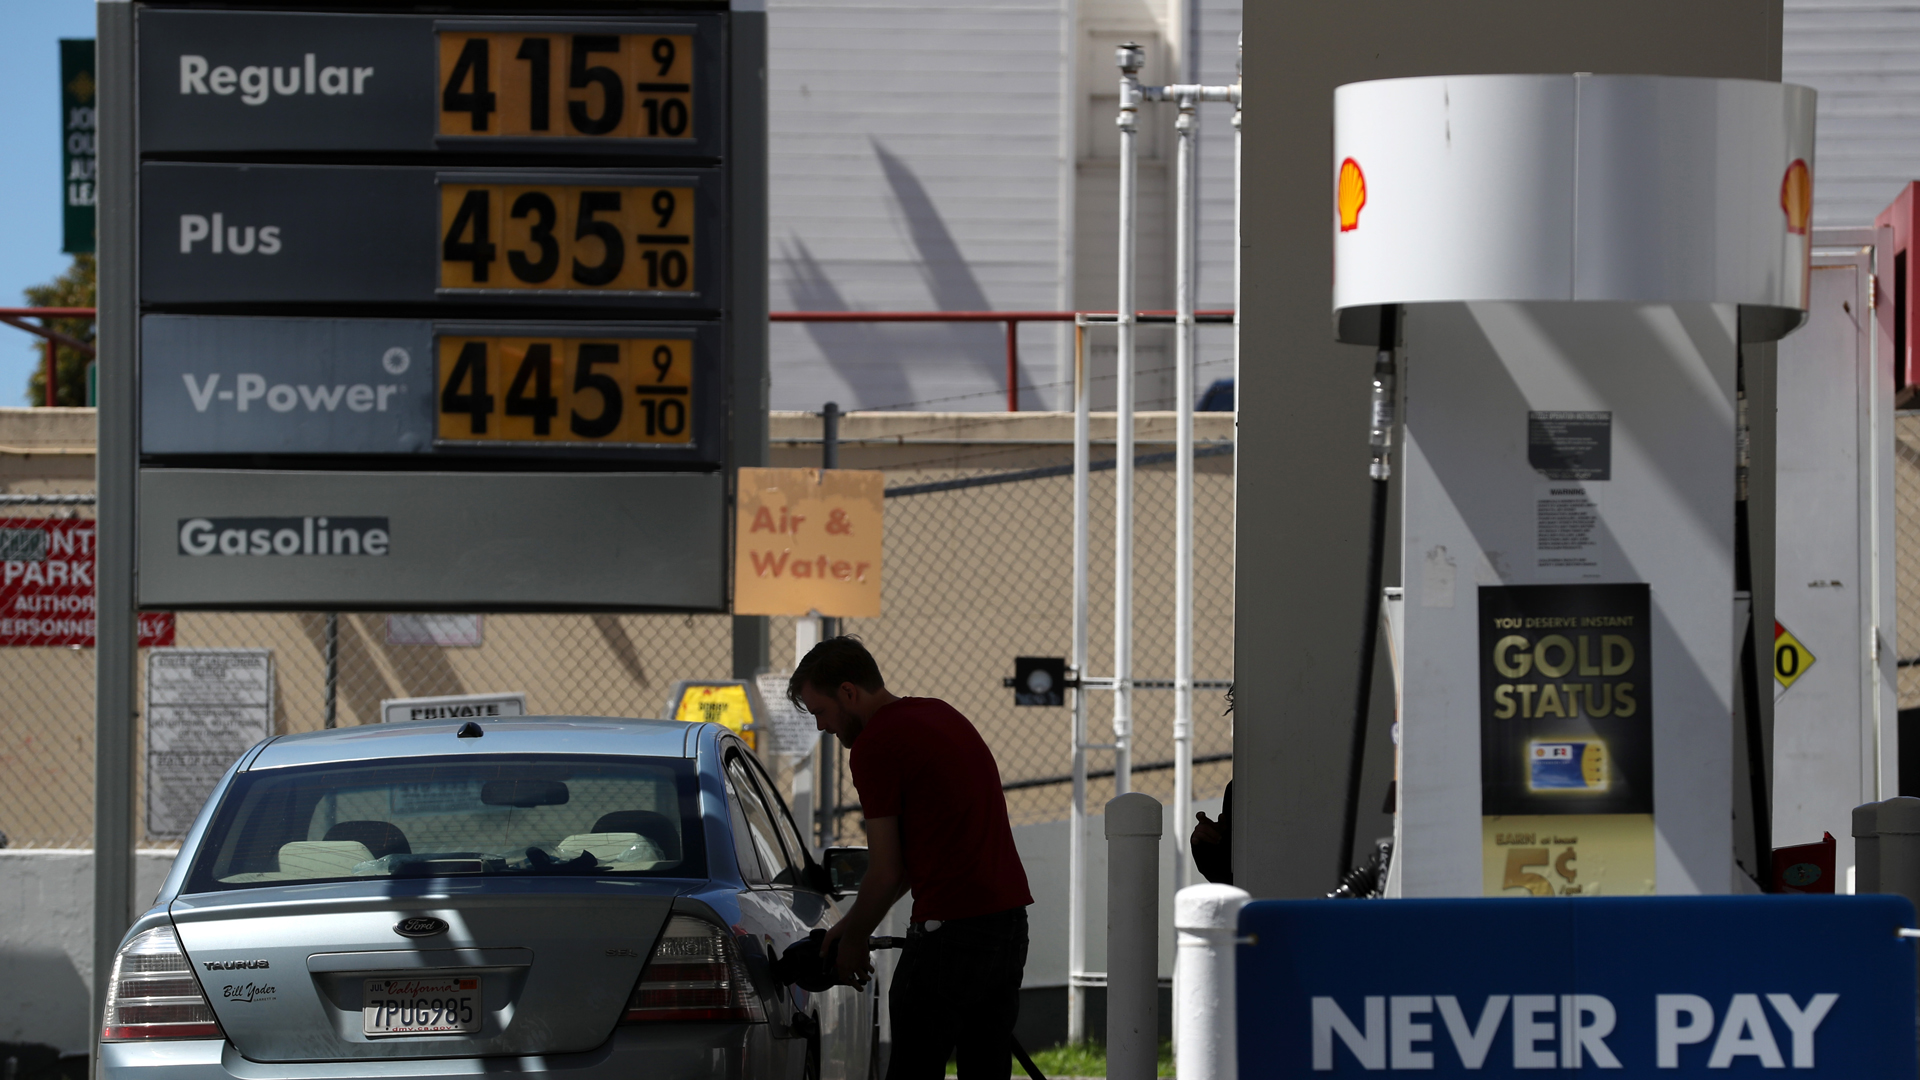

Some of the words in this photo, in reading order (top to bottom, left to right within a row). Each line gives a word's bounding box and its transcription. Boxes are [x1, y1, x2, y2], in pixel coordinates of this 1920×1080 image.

[652, 38, 675, 76] 9
[180, 55, 374, 107] Regular
[442, 37, 625, 135] 415
[644, 98, 688, 137] 10
[68, 131, 95, 155] OU
[652, 190, 675, 229] 9
[180, 215, 281, 255] Plus
[442, 190, 625, 286] 435
[644, 249, 688, 288] 10
[652, 346, 674, 383] 9
[183, 373, 396, 413] V-Power
[441, 342, 623, 438] 445
[643, 399, 685, 436] 10
[180, 517, 390, 557] Gasoline
[750, 506, 805, 534] Air
[825, 508, 853, 535] &
[5, 560, 92, 586] PARK
[750, 550, 871, 581] Water
[15, 595, 95, 612] AUTHOR
[0, 618, 95, 636] ERSONNE
[1494, 618, 1522, 629] YOU
[1525, 617, 1577, 628] DESERVE
[1581, 616, 1634, 627] INSTANT
[1493, 634, 1635, 679] GOLD
[1776, 644, 1799, 677] 0
[411, 705, 499, 720] PRIVATE
[1494, 682, 1636, 719] STATUS
[1496, 833, 1536, 845] EARN
[404, 918, 436, 930] Ford
[203, 959, 270, 971] TAURUS
[605, 948, 638, 957] SEL
[223, 985, 243, 998] Bill
[246, 982, 276, 1003] Yoder
[370, 984, 384, 992] JUL
[388, 981, 459, 998] California
[371, 997, 473, 1027] 7PUG985
[1312, 994, 1622, 1070] NEVER
[1656, 993, 1839, 1069] PAY
